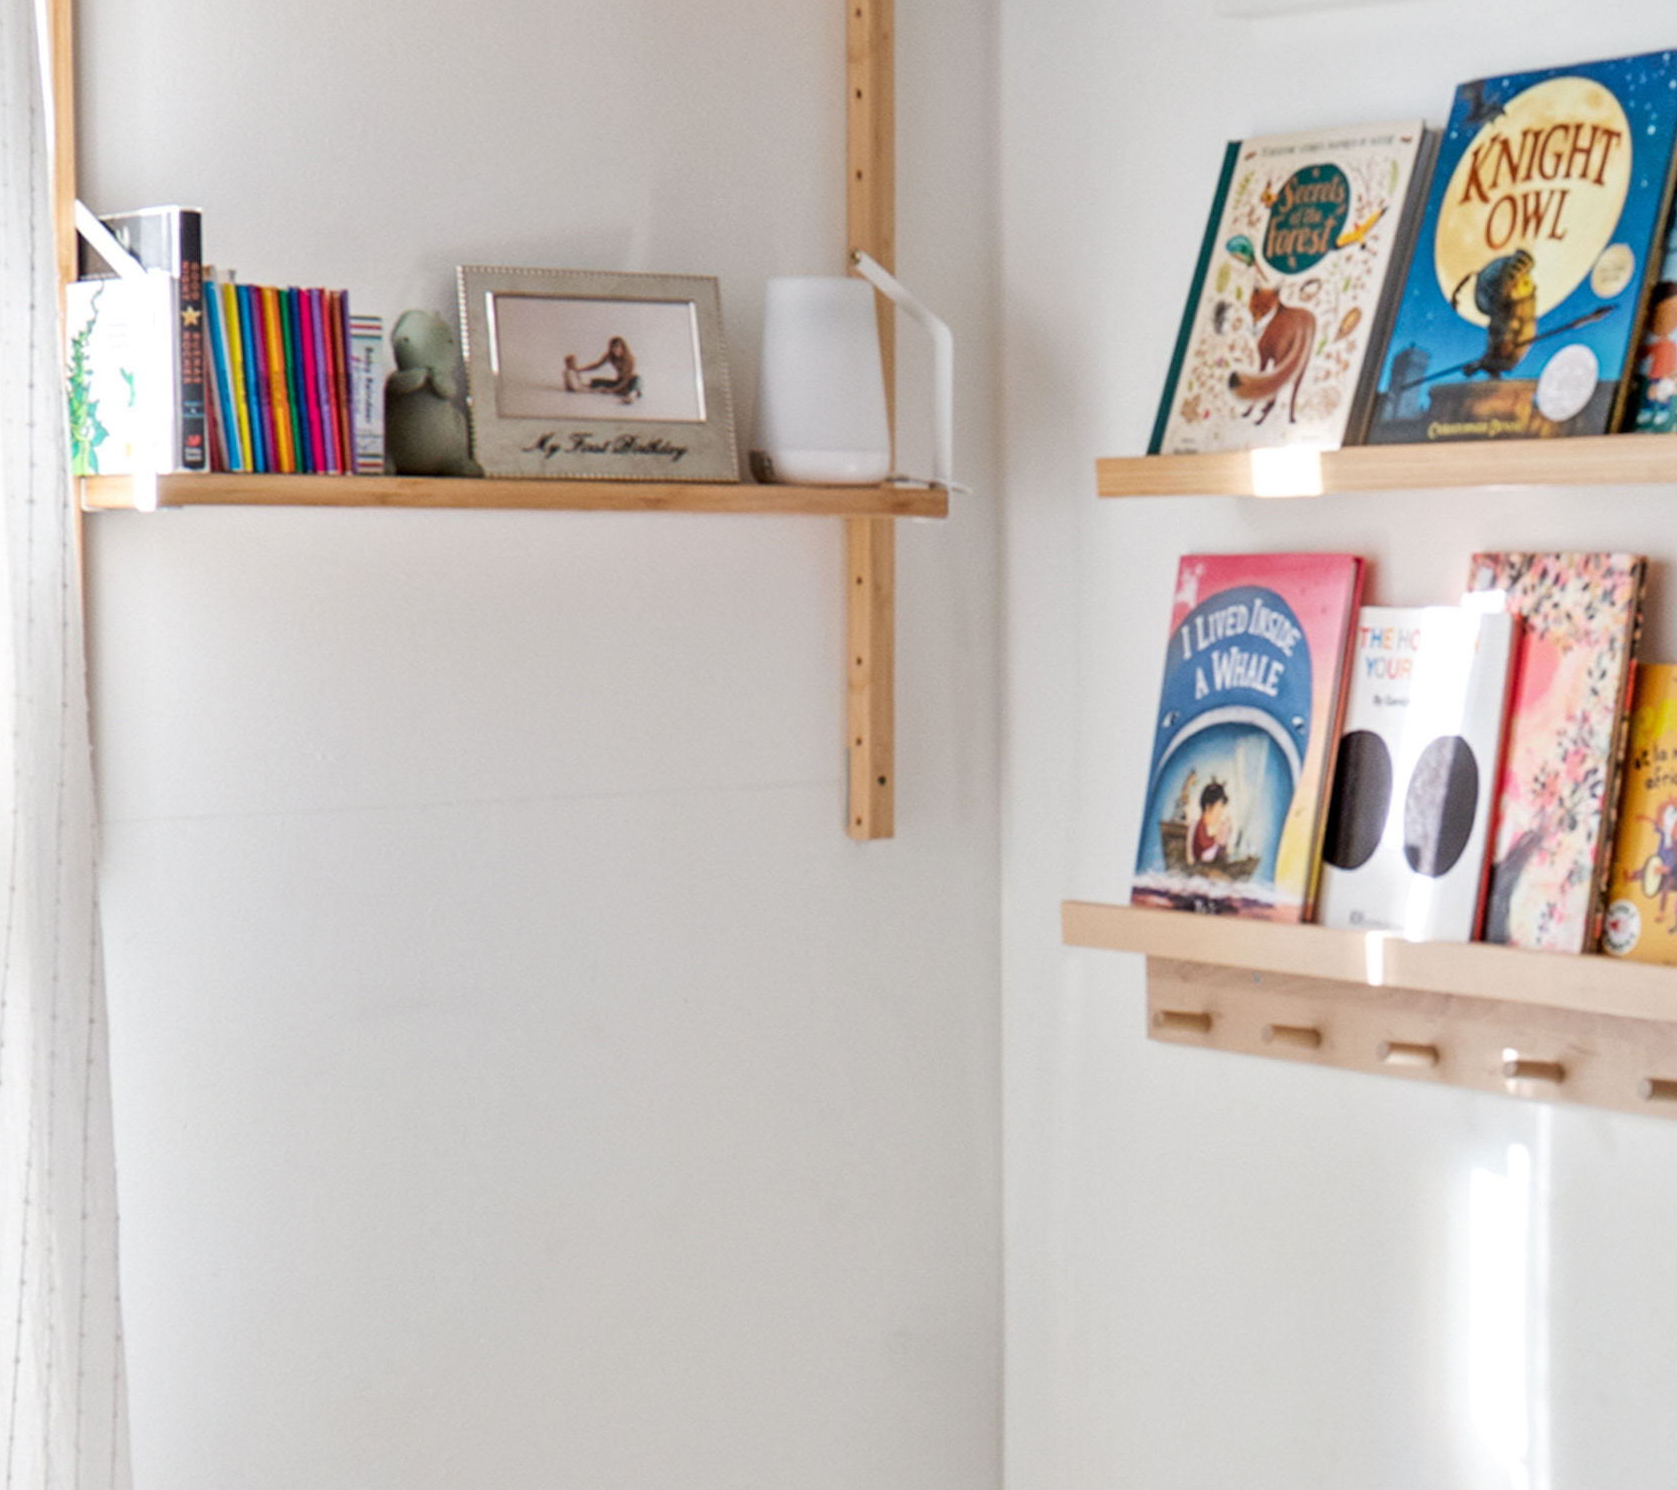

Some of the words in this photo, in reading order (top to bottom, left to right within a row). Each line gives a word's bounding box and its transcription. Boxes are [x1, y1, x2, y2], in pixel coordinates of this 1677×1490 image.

[1459, 122, 1622, 205] KNIGHT
[1279, 174, 1345, 213] Secrets
[1266, 215, 1336, 258] Forest
[1485, 189, 1570, 251] OWL
[190, 261, 200, 300] GOOD
[522, 432, 560, 458] My
[564, 432, 608, 454] First
[612, 434, 689, 462] Birthday
[1181, 625, 1192, 661] I
[1195, 604, 1249, 651] LIVED
[1248, 598, 1302, 658] INSIDE
[1361, 627, 1394, 650] THE
[1195, 667, 1210, 700] A
[1211, 646, 1285, 697] WHALE
[1365, 656, 1412, 681] YOUR
